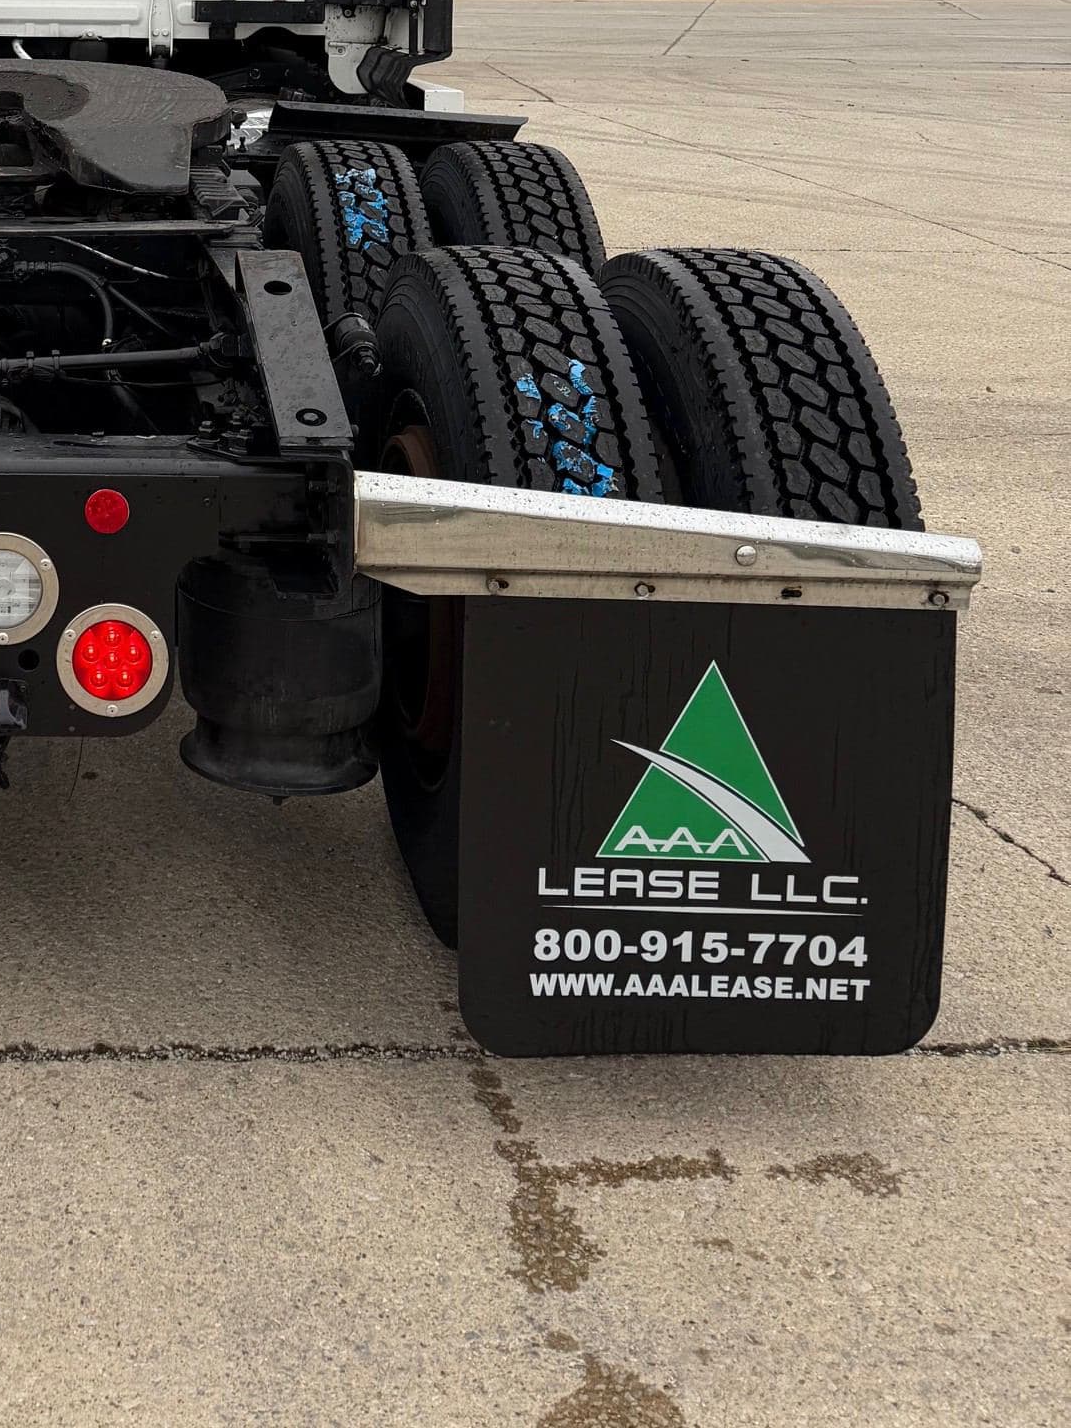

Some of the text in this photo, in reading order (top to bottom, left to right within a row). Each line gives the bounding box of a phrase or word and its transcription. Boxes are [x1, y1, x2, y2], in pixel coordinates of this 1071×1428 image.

[613, 825, 750, 856] AAA
[538, 867, 868, 905] LEASE LLC.
[533, 928, 868, 967] 800-915-7704
[529, 973, 871, 1001] WWW.AAALEASE.NET
